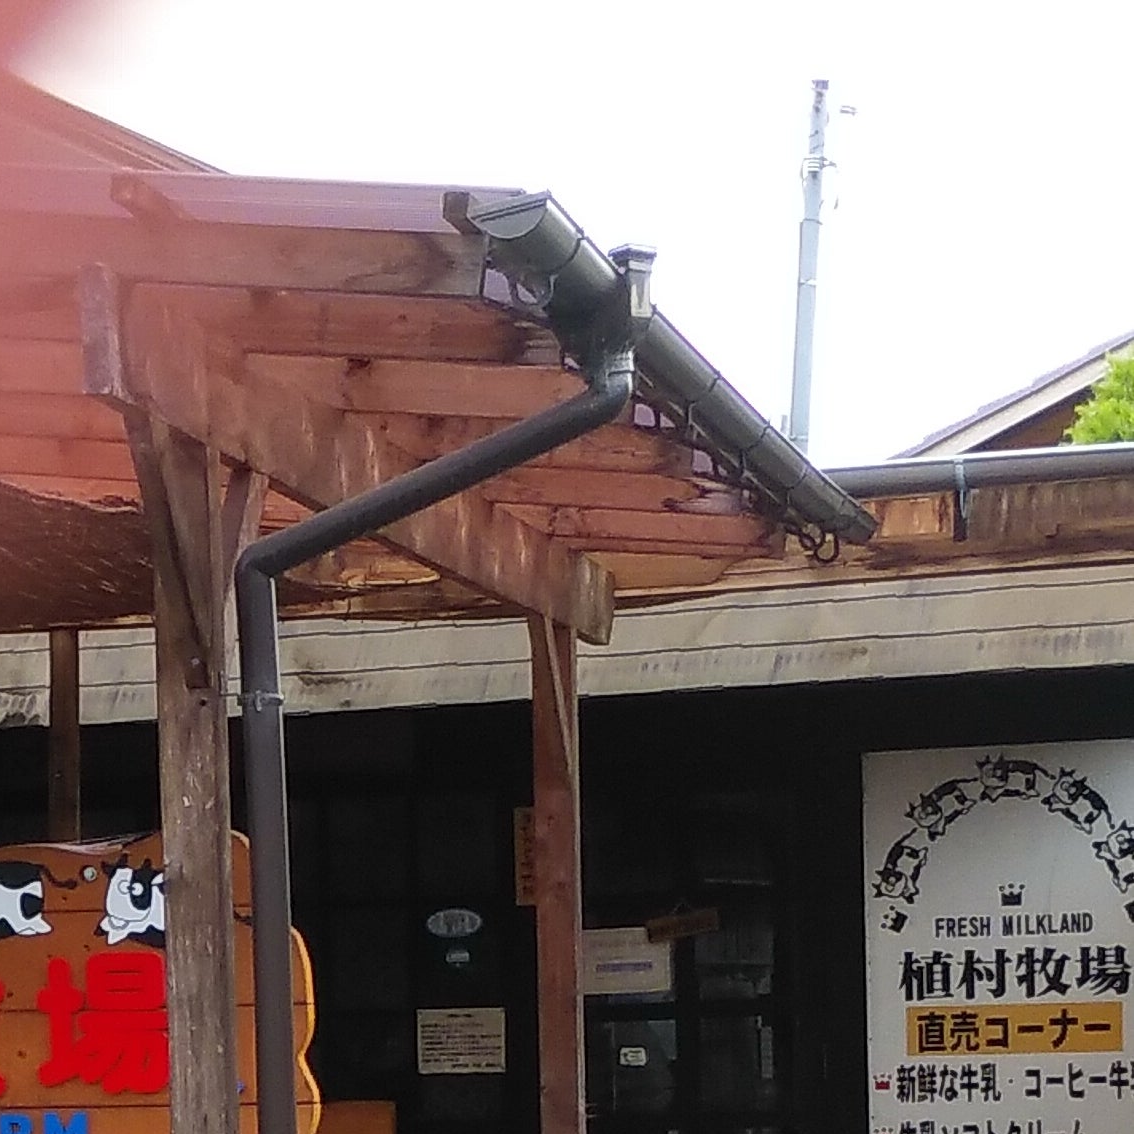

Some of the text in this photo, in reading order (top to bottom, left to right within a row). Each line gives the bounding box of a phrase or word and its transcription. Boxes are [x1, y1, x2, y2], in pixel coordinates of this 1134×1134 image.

[934, 912, 1094, 938] FRESH MILKLAND
[898, 944, 1133, 1001] 植村牧場
[916, 1008, 1112, 1053] 直売コーナー
[896, 1060, 1134, 1103] 新鮮な牛乳・コーヒー牛
